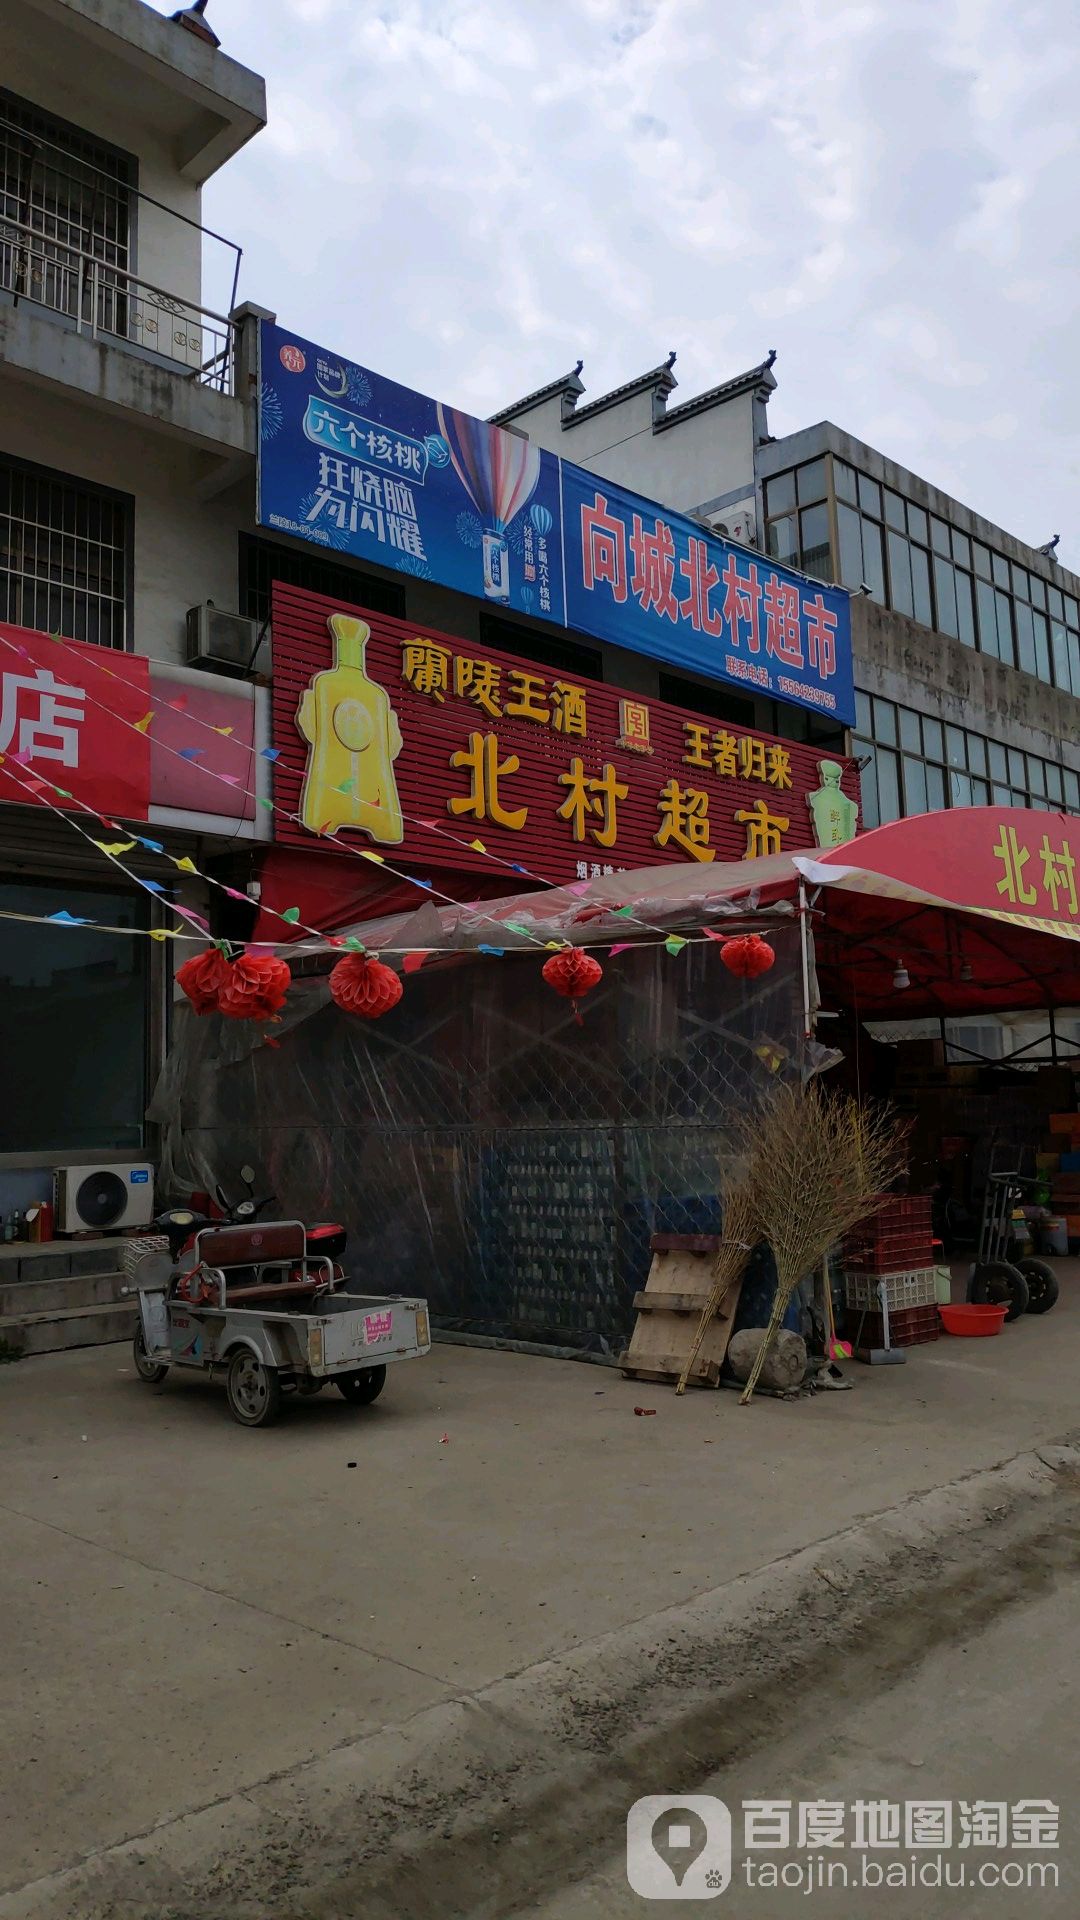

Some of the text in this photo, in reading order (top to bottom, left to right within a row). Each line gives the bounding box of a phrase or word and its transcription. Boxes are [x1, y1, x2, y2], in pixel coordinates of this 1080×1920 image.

[313, 409, 421, 475] 六个核桃
[305, 486, 428, 562] 为闪耀
[319, 452, 417, 522] 狂烧脑
[537, 536, 551, 613] 多喝六个核桃
[580, 492, 838, 680] 向城北村超市
[0, 669, 85, 769] 店
[682, 721, 793, 790] 王者归来
[447, 731, 790, 864] 北村超市
[993, 824, 1079, 915] 北村
